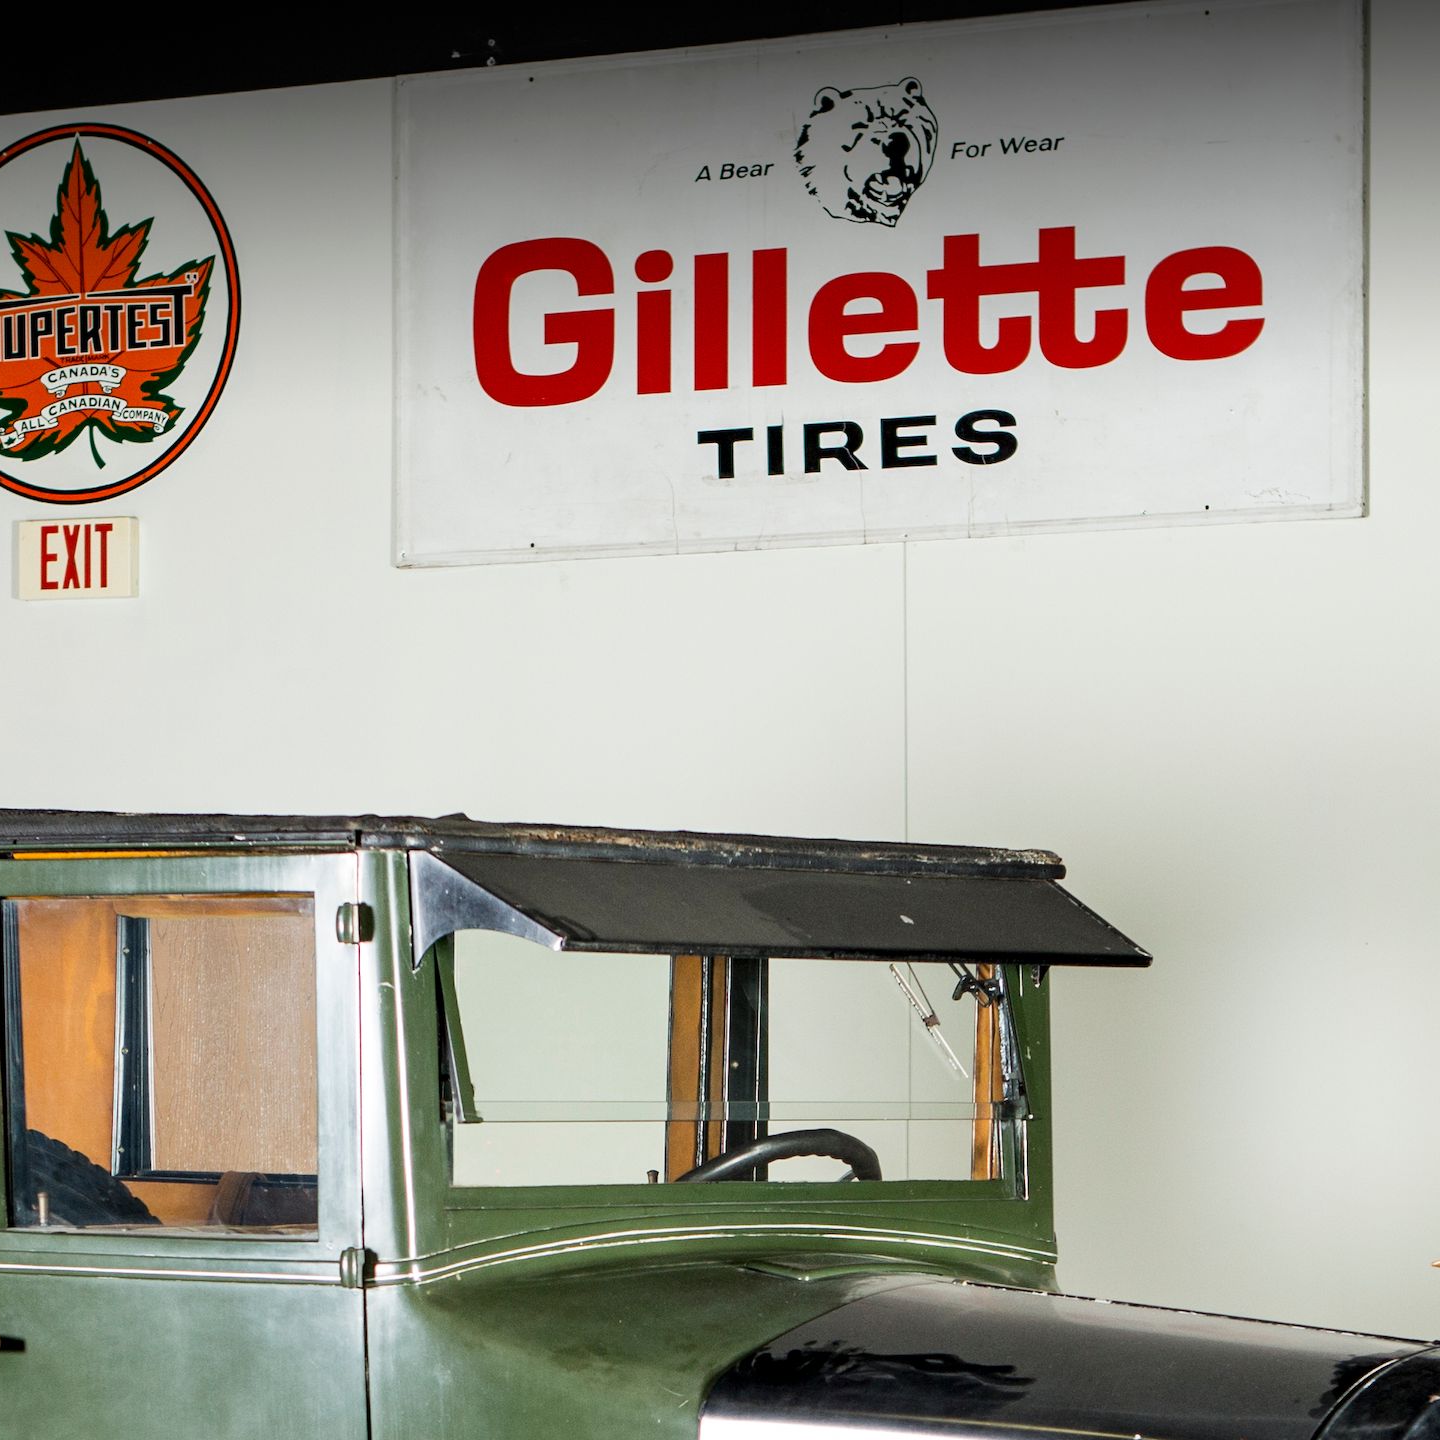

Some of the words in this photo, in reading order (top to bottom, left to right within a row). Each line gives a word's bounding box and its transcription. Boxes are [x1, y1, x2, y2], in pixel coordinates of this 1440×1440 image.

[949, 140, 993, 161] For
[999, 133, 1065, 157] Wear
[695, 164, 714, 183] A
[718, 158, 775, 182] Bear
[472, 226, 1266, 408] Gillette
[61, 354, 85, 363] TRADE
[87, 353, 110, 362] MARK
[47, 365, 120, 384] CANADA'S
[20, 419, 45, 432] ALL
[48, 397, 122, 416] CANADIAN
[122, 408, 168, 425] COMPANY
[696, 409, 1019, 479] TIRES
[39, 522, 114, 591] EXIT
